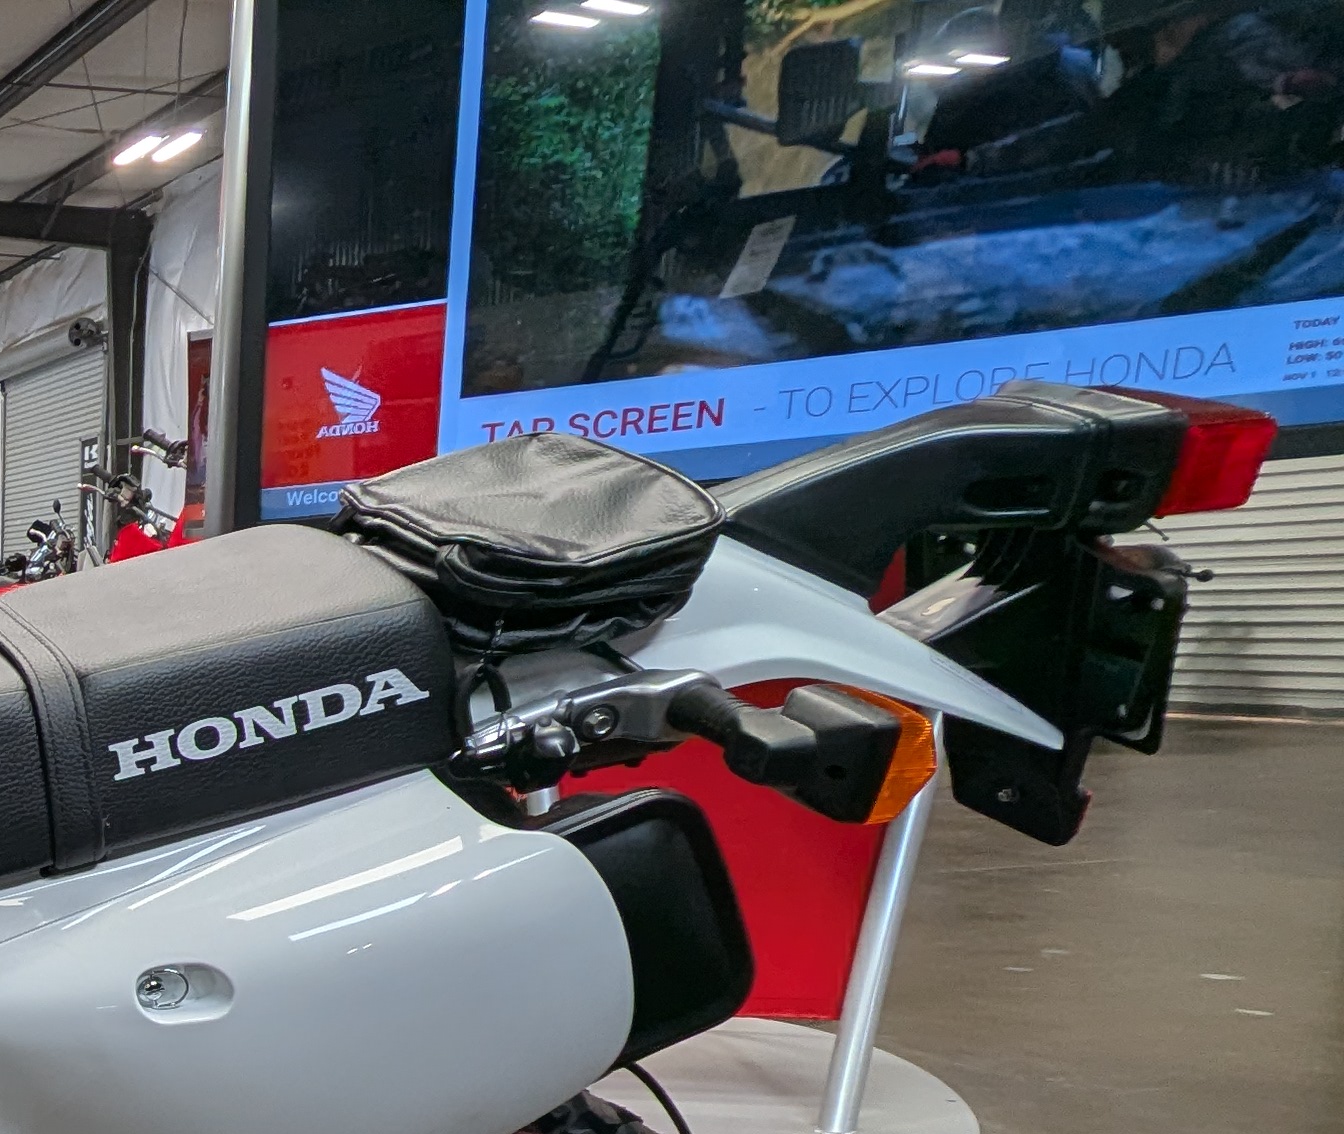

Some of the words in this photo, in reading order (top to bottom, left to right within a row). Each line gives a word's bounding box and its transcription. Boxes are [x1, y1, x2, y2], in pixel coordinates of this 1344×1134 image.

[1293, 315, 1340, 330] TODAY
[568, 398, 725, 439] SCREEN
[779, 386, 833, 420] TO
[1066, 342, 1237, 387] HONDA
[286, 489, 340, 507] Welco
[108, 668, 430, 782] HONDA
